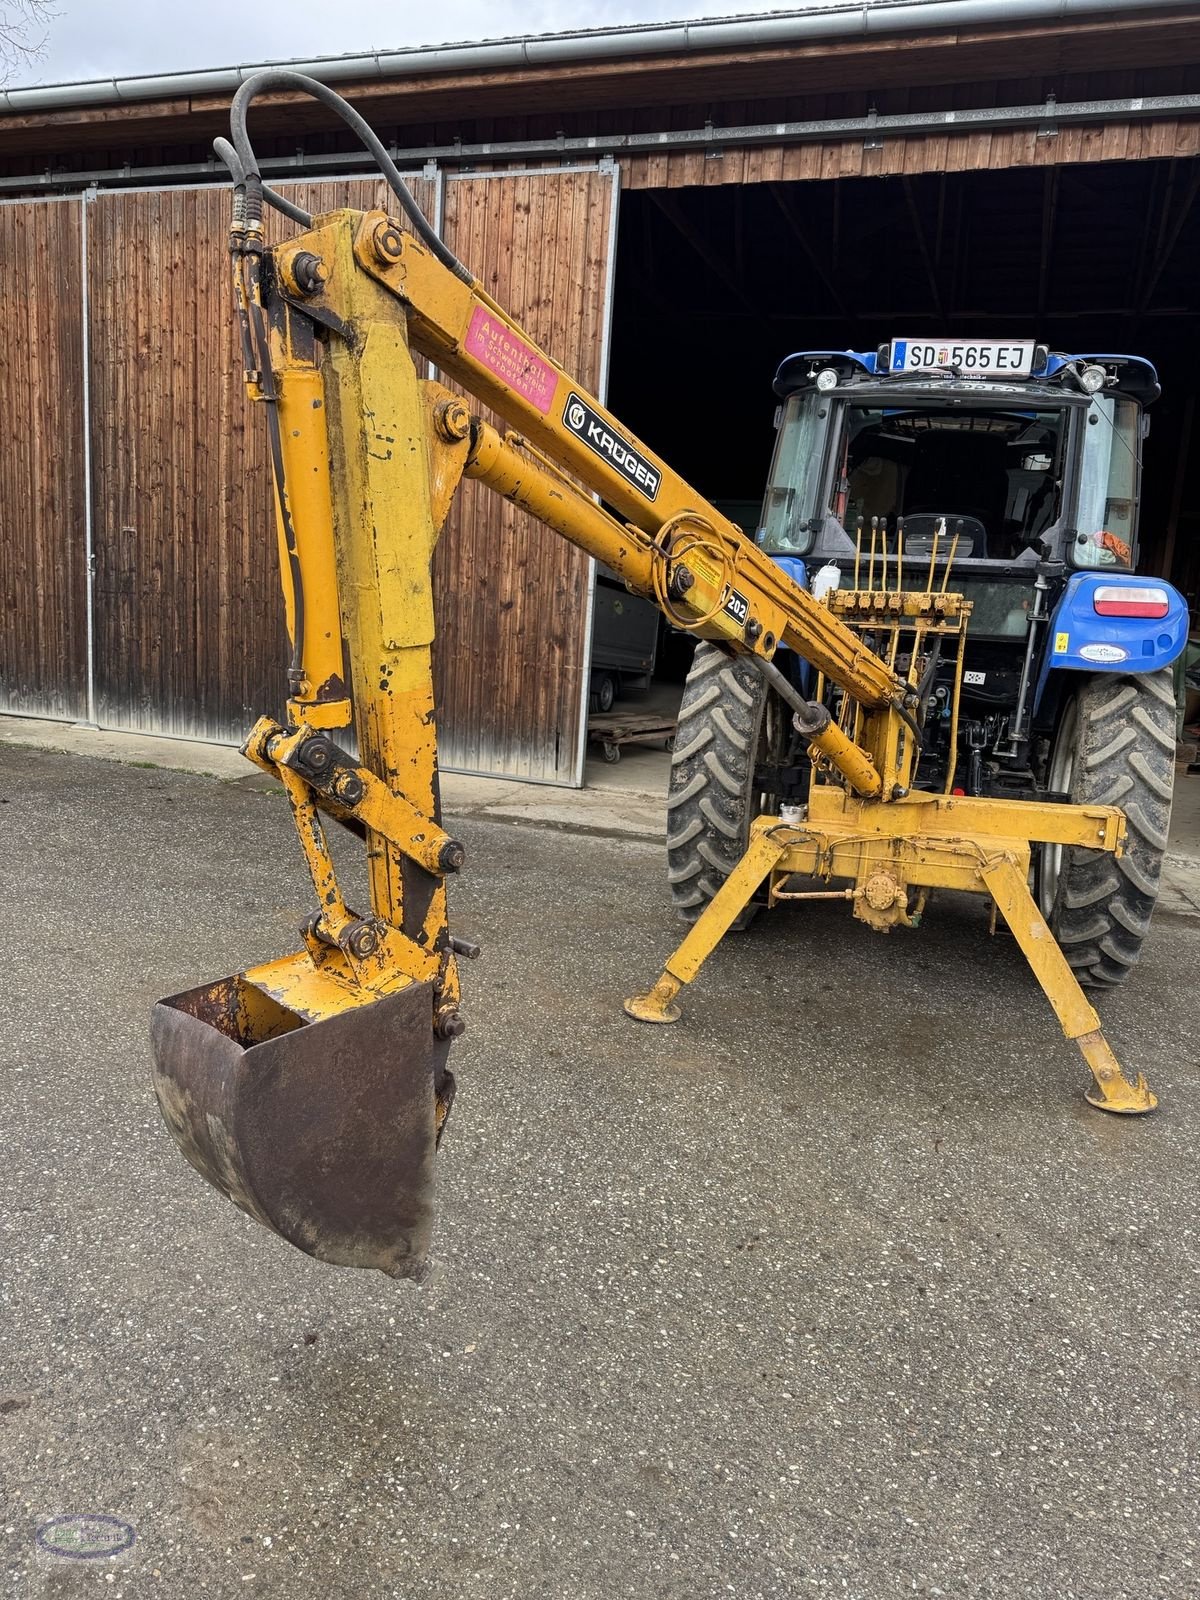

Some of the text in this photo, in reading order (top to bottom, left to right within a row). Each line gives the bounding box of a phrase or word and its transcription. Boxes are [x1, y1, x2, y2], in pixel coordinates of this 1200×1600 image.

[482, 321, 547, 382] Aufenthalt
[910, 346, 1024, 369] SD 565 EJ
[587, 421, 658, 493] KRÜGER
